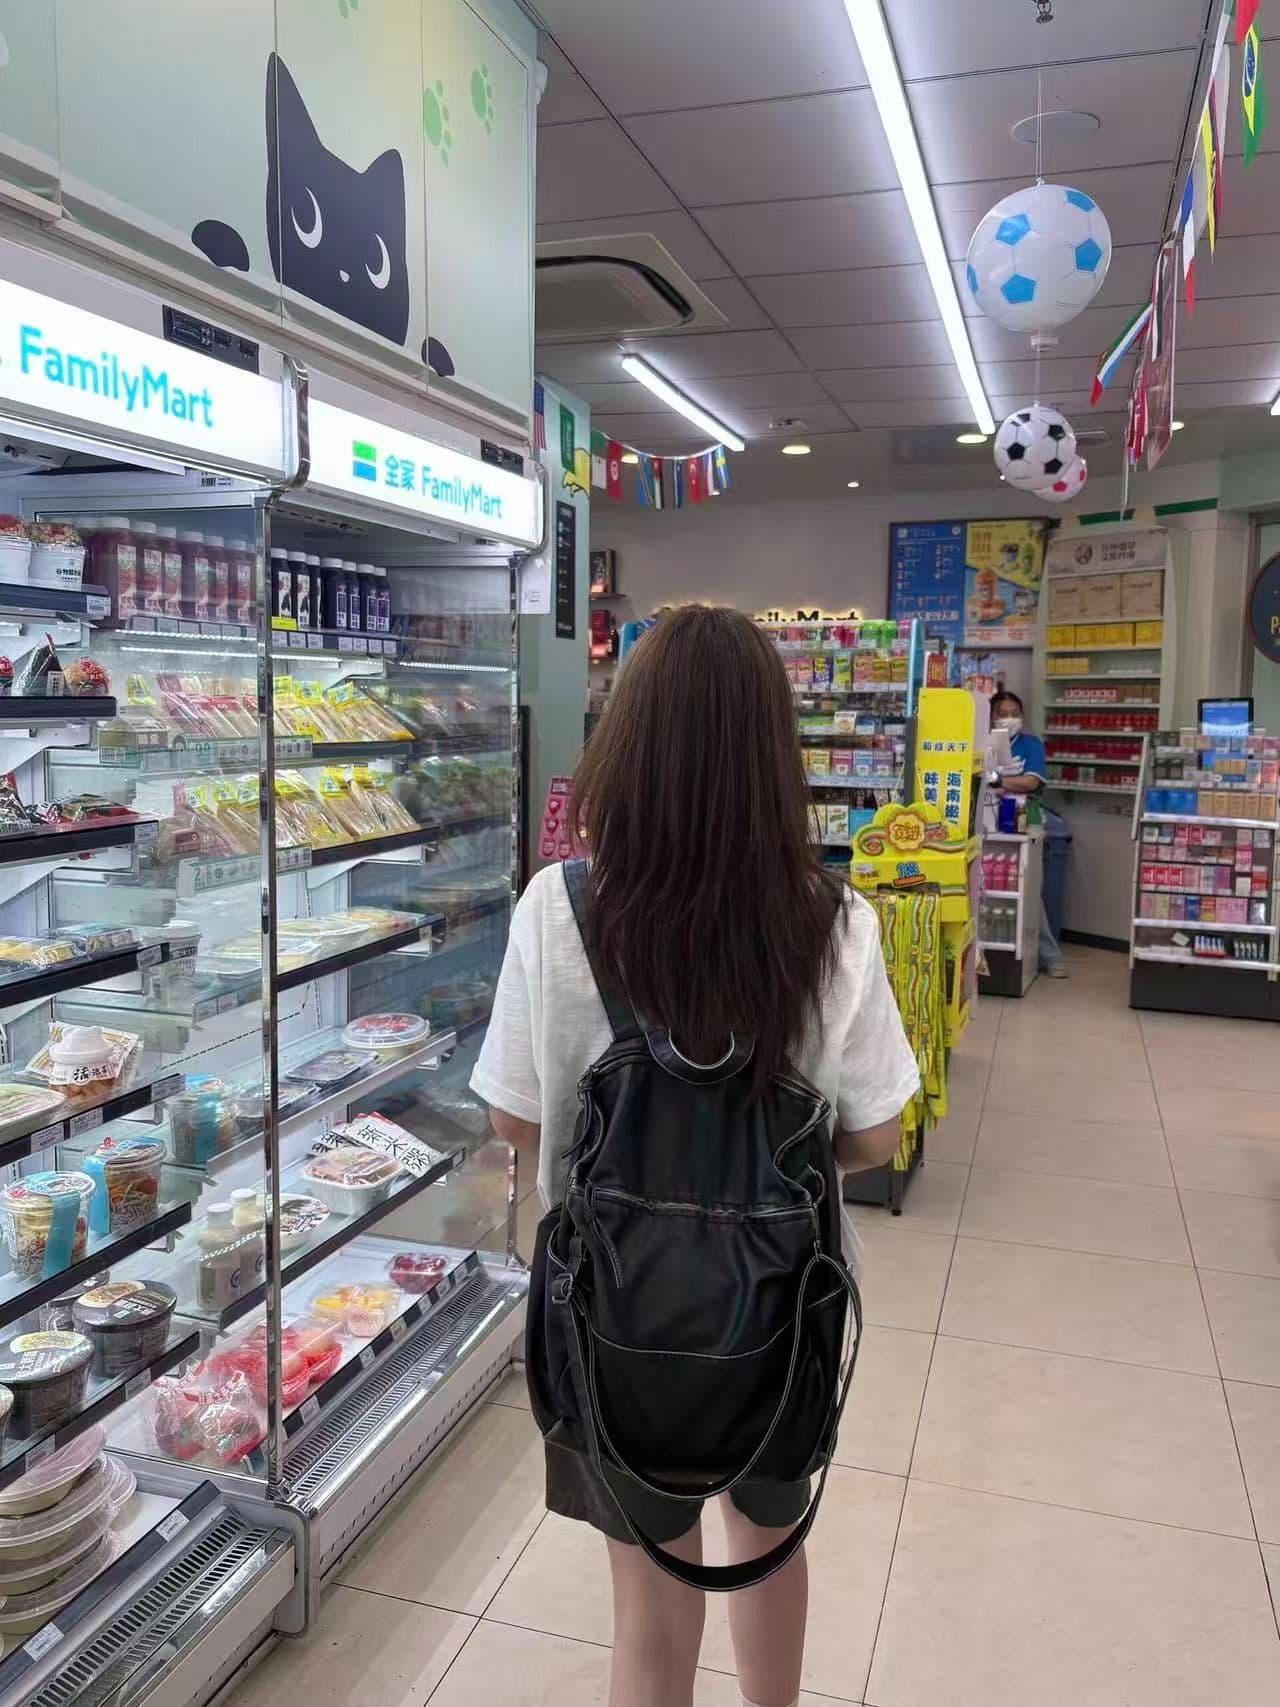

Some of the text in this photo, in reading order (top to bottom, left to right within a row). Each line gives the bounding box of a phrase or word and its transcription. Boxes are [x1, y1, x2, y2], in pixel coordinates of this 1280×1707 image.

[19, 324, 214, 428] FamilyMart
[385, 455, 503, 519] 全家 FamilyMart
